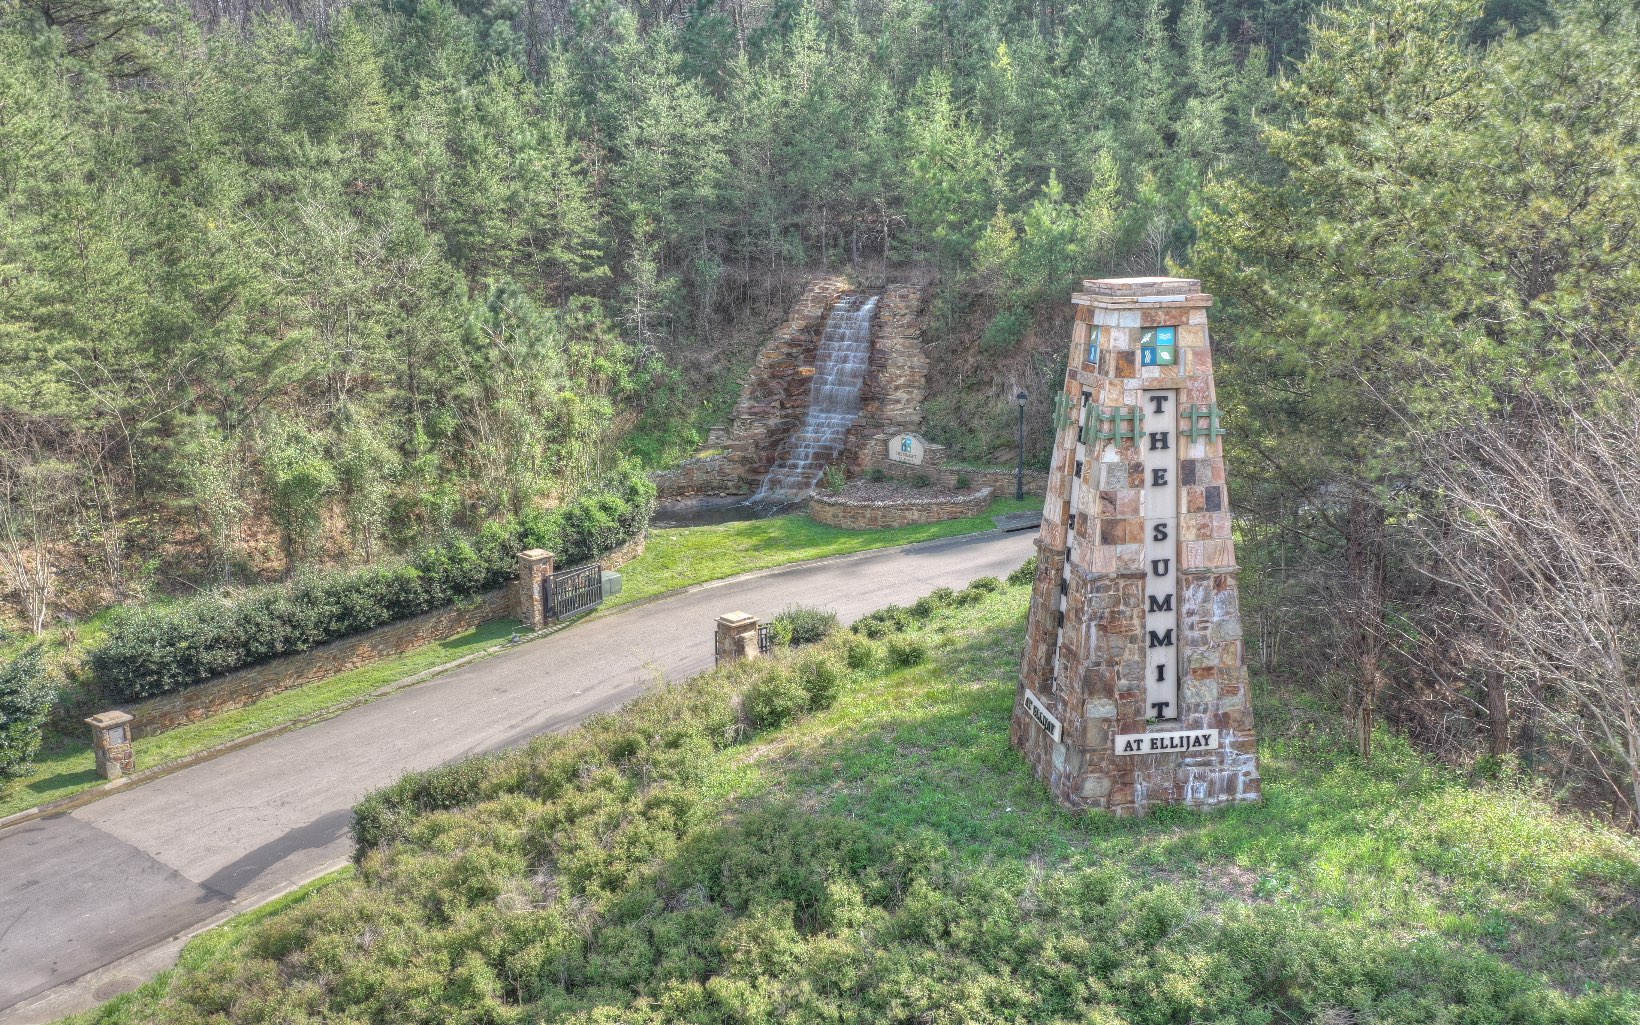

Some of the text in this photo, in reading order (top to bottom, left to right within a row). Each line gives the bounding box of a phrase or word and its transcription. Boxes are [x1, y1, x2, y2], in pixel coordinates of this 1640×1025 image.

[1148, 395, 1174, 719] THE SUMMIT
[1024, 697, 1056, 736] AT ELLIJAY
[1123, 733, 1212, 752] AT ELLIJAY
